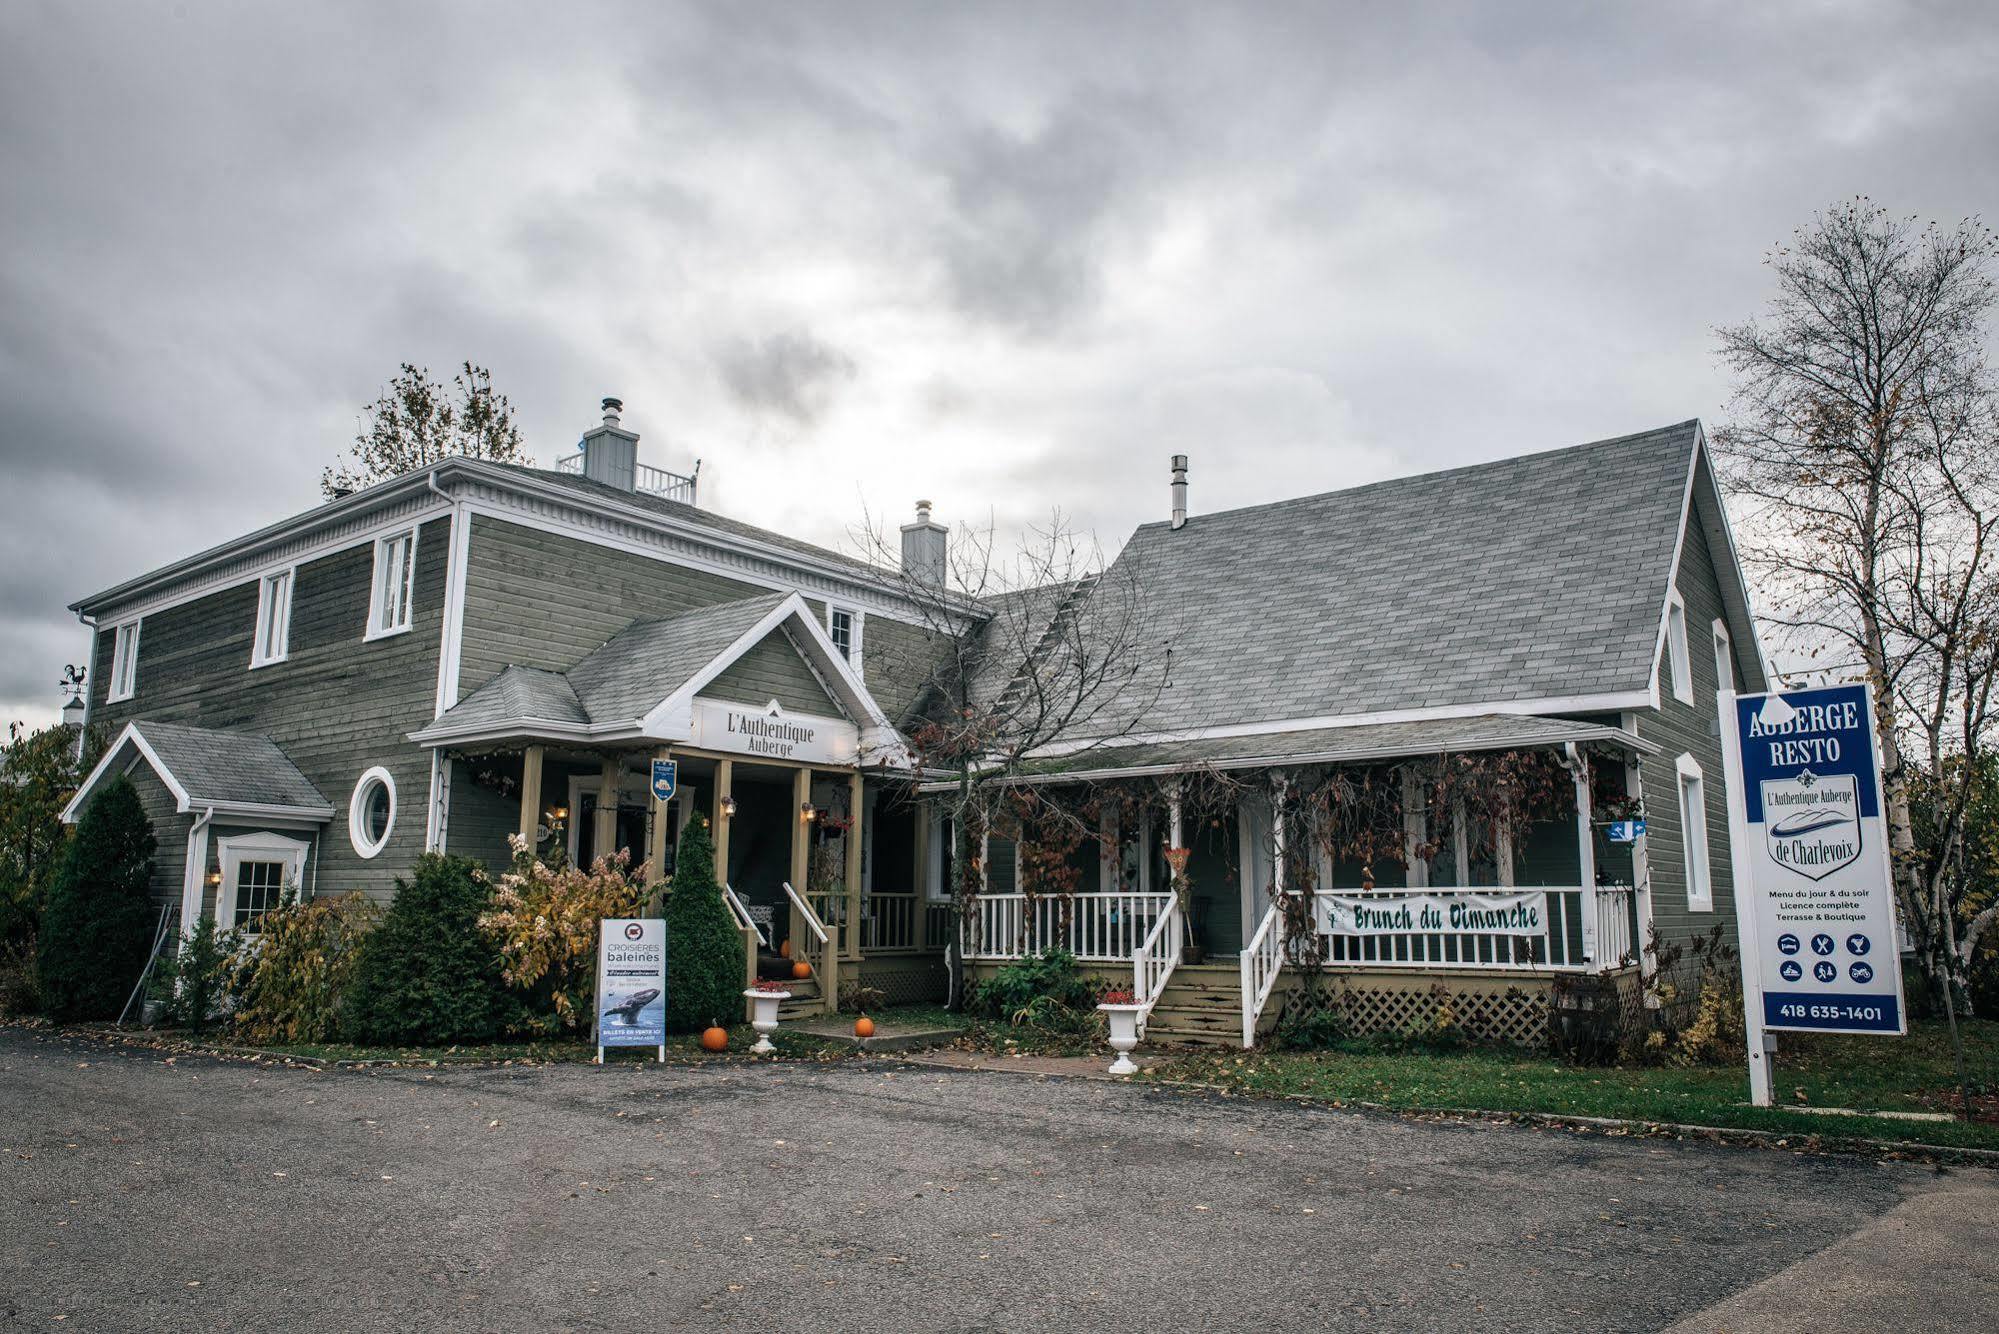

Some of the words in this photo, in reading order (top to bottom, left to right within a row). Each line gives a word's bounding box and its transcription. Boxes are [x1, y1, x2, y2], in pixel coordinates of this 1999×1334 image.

[728, 713, 815, 744] L'Authentique
[748, 736, 793, 758] Auberge
[1769, 737, 1840, 766] RESTO
[1767, 791, 1819, 806] L'Authentique
[1820, 789, 1852, 804] Auberge
[1776, 840, 1789, 862] de
[1792, 840, 1854, 865] Charlevoix
[1796, 890, 1807, 898] du
[1809, 890, 1827, 899] jour
[1829, 890, 1836, 898] &
[1838, 889, 1850, 897] du
[1852, 889, 1869, 897] soir
[1780, 902, 1814, 910] Licence
[1816, 901, 1860, 911] complète
[1354, 904, 1413, 929] Brunch
[1420, 904, 1442, 929] du
[1450, 901, 1539, 929] Dimanche
[1824, 913, 1866, 922] Boutique
[608, 952, 660, 962] baleines
[1780, 1005, 1806, 1018] 418
[1810, 1005, 1882, 1021] 635-1401
